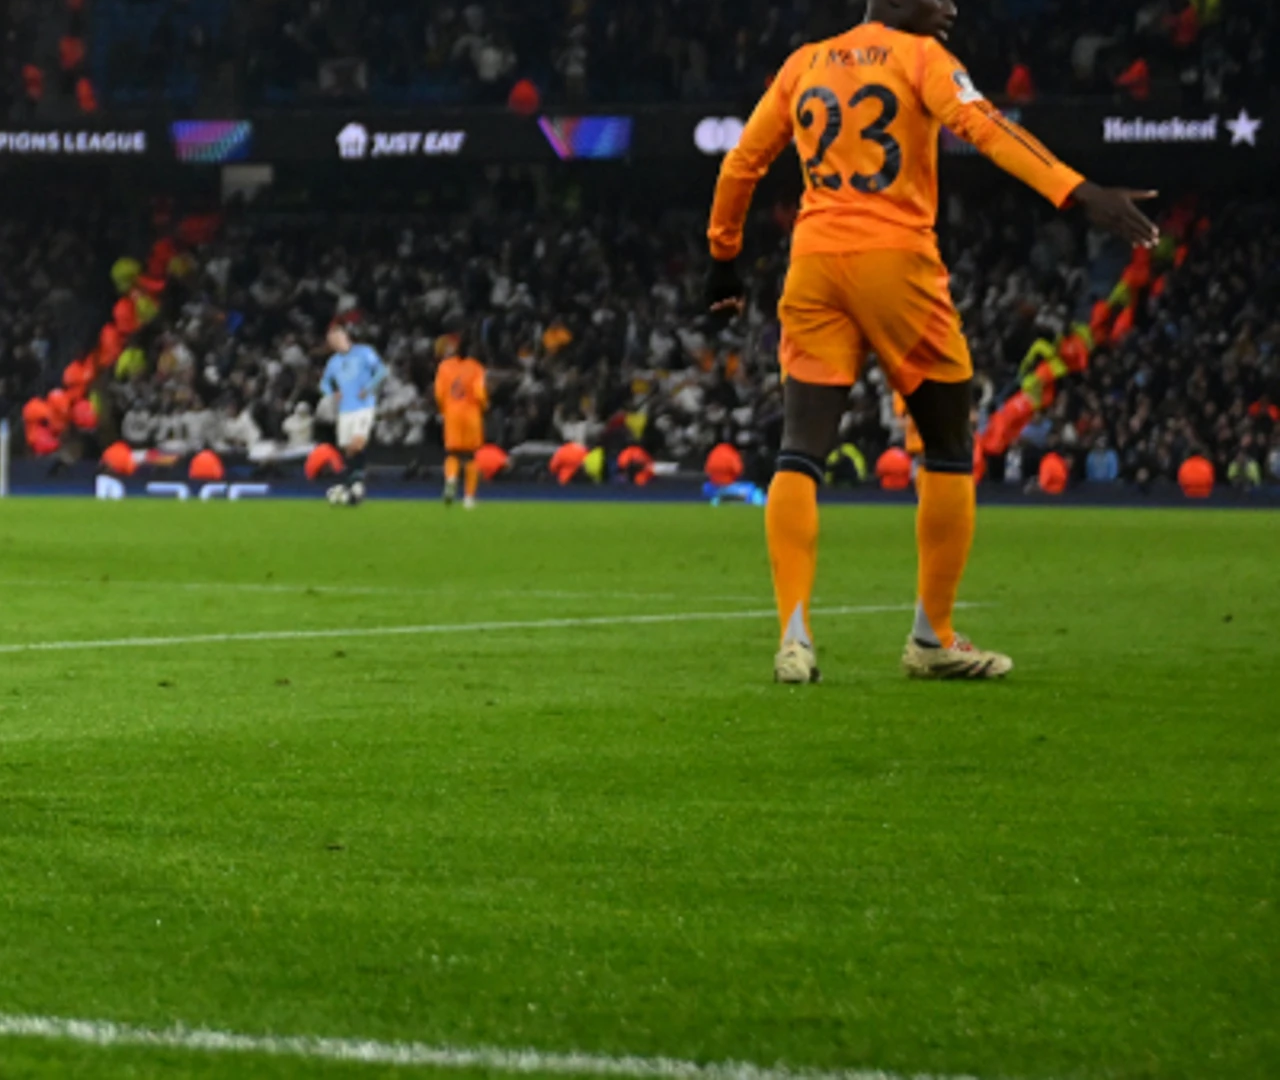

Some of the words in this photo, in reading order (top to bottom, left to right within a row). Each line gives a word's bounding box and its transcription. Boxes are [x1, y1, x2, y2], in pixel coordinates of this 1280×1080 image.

[796, 83, 902, 193] 23
[1103, 114, 1219, 142] Heineken
[63, 131, 146, 153] LEAGUE
[371, 131, 423, 156] JUST
[423, 131, 465, 155] EAT
